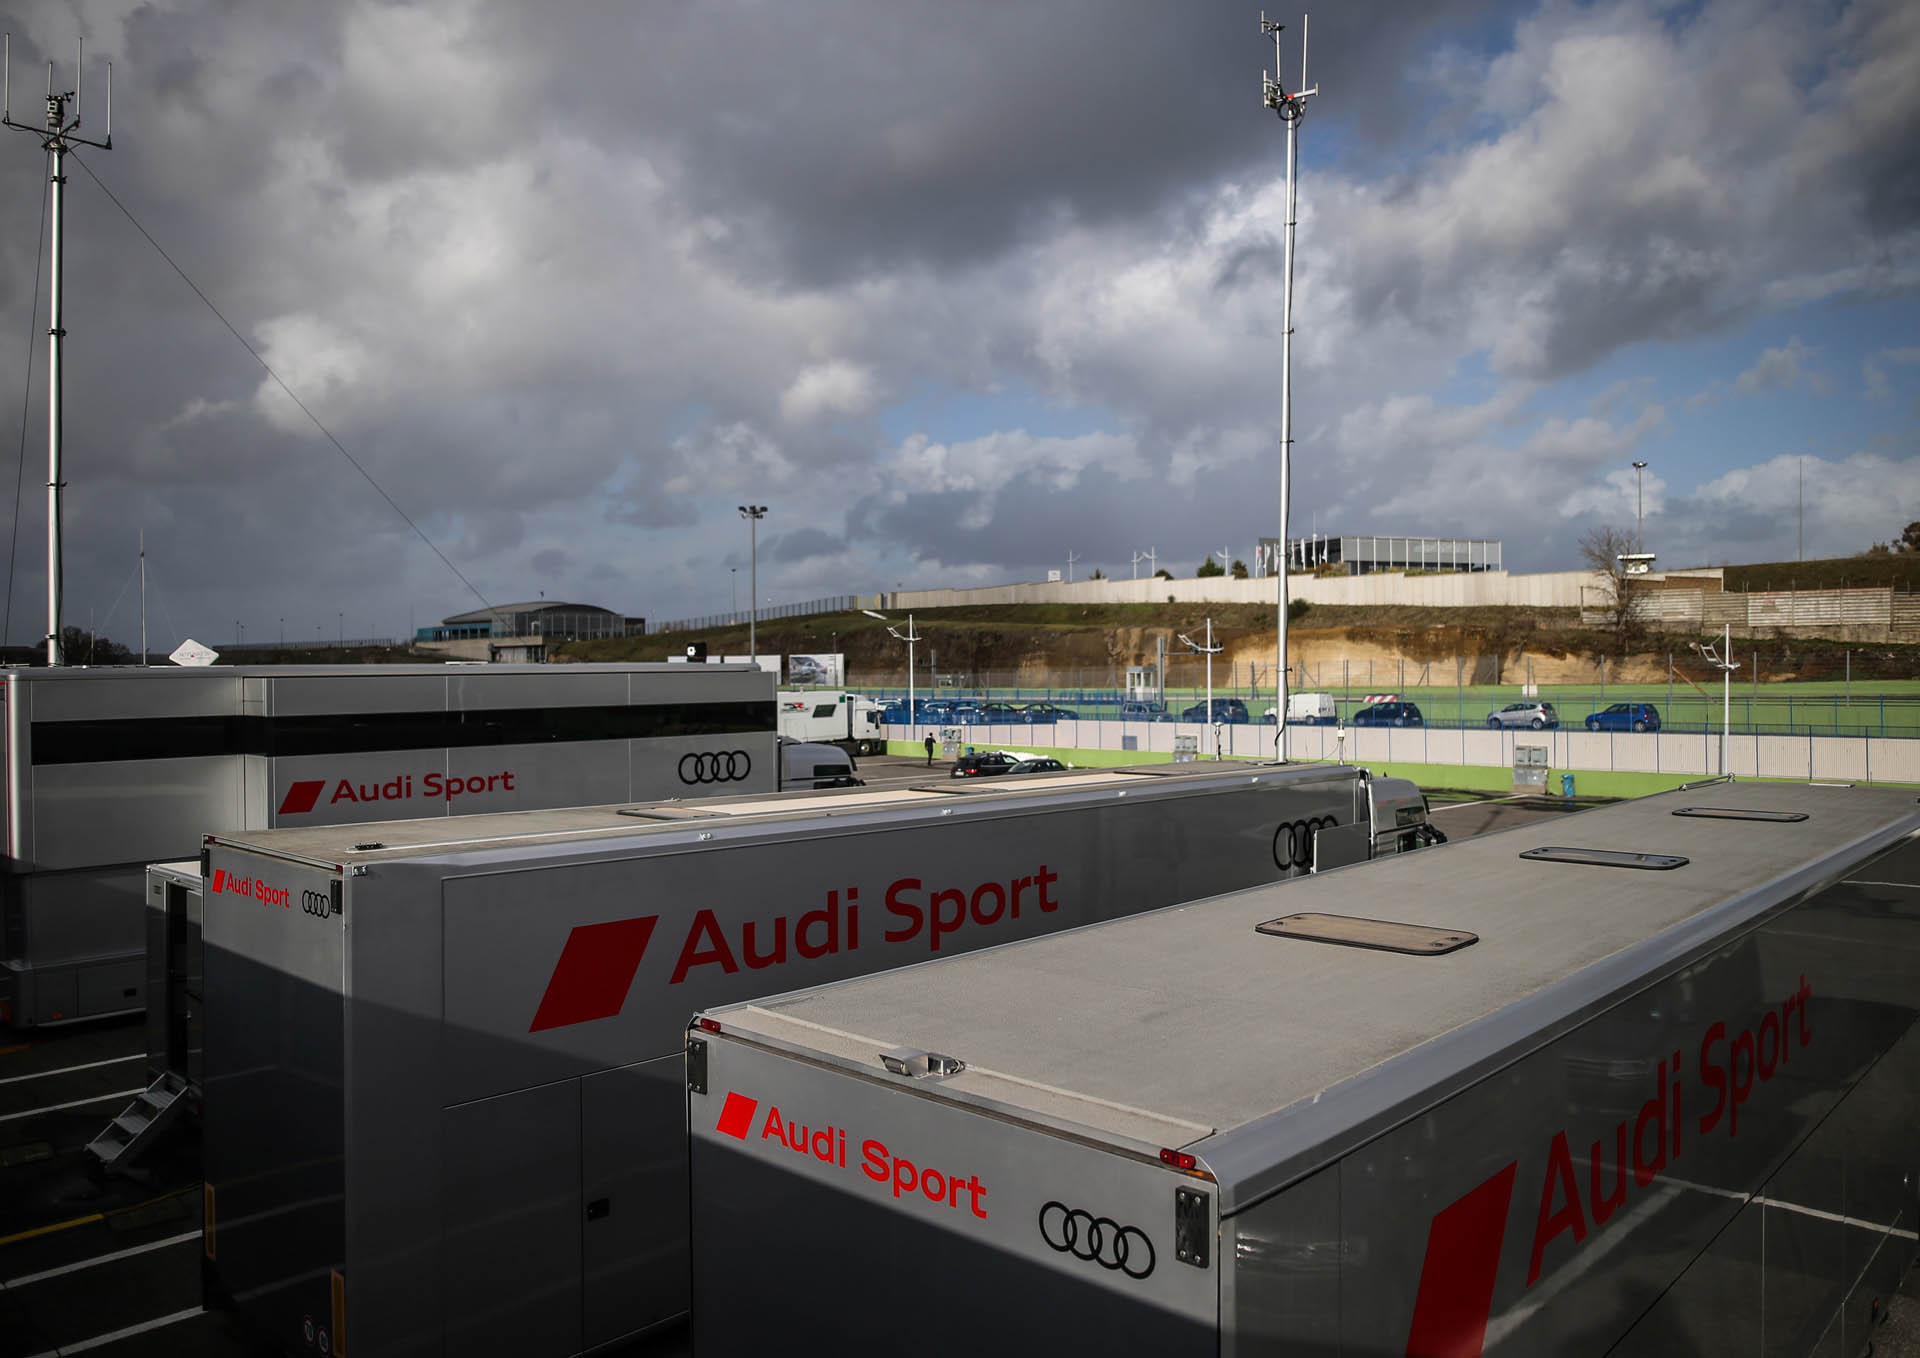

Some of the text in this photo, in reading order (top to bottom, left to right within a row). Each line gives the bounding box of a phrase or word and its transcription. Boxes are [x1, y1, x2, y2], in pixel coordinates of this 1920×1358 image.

[330, 771, 515, 804] Audi Sport
[226, 872, 291, 910] Audi Sport
[669, 865, 1059, 985] Audi Sport
[761, 1106, 988, 1220] Audi Sport
[1527, 974, 1812, 1289] Audi Sport
